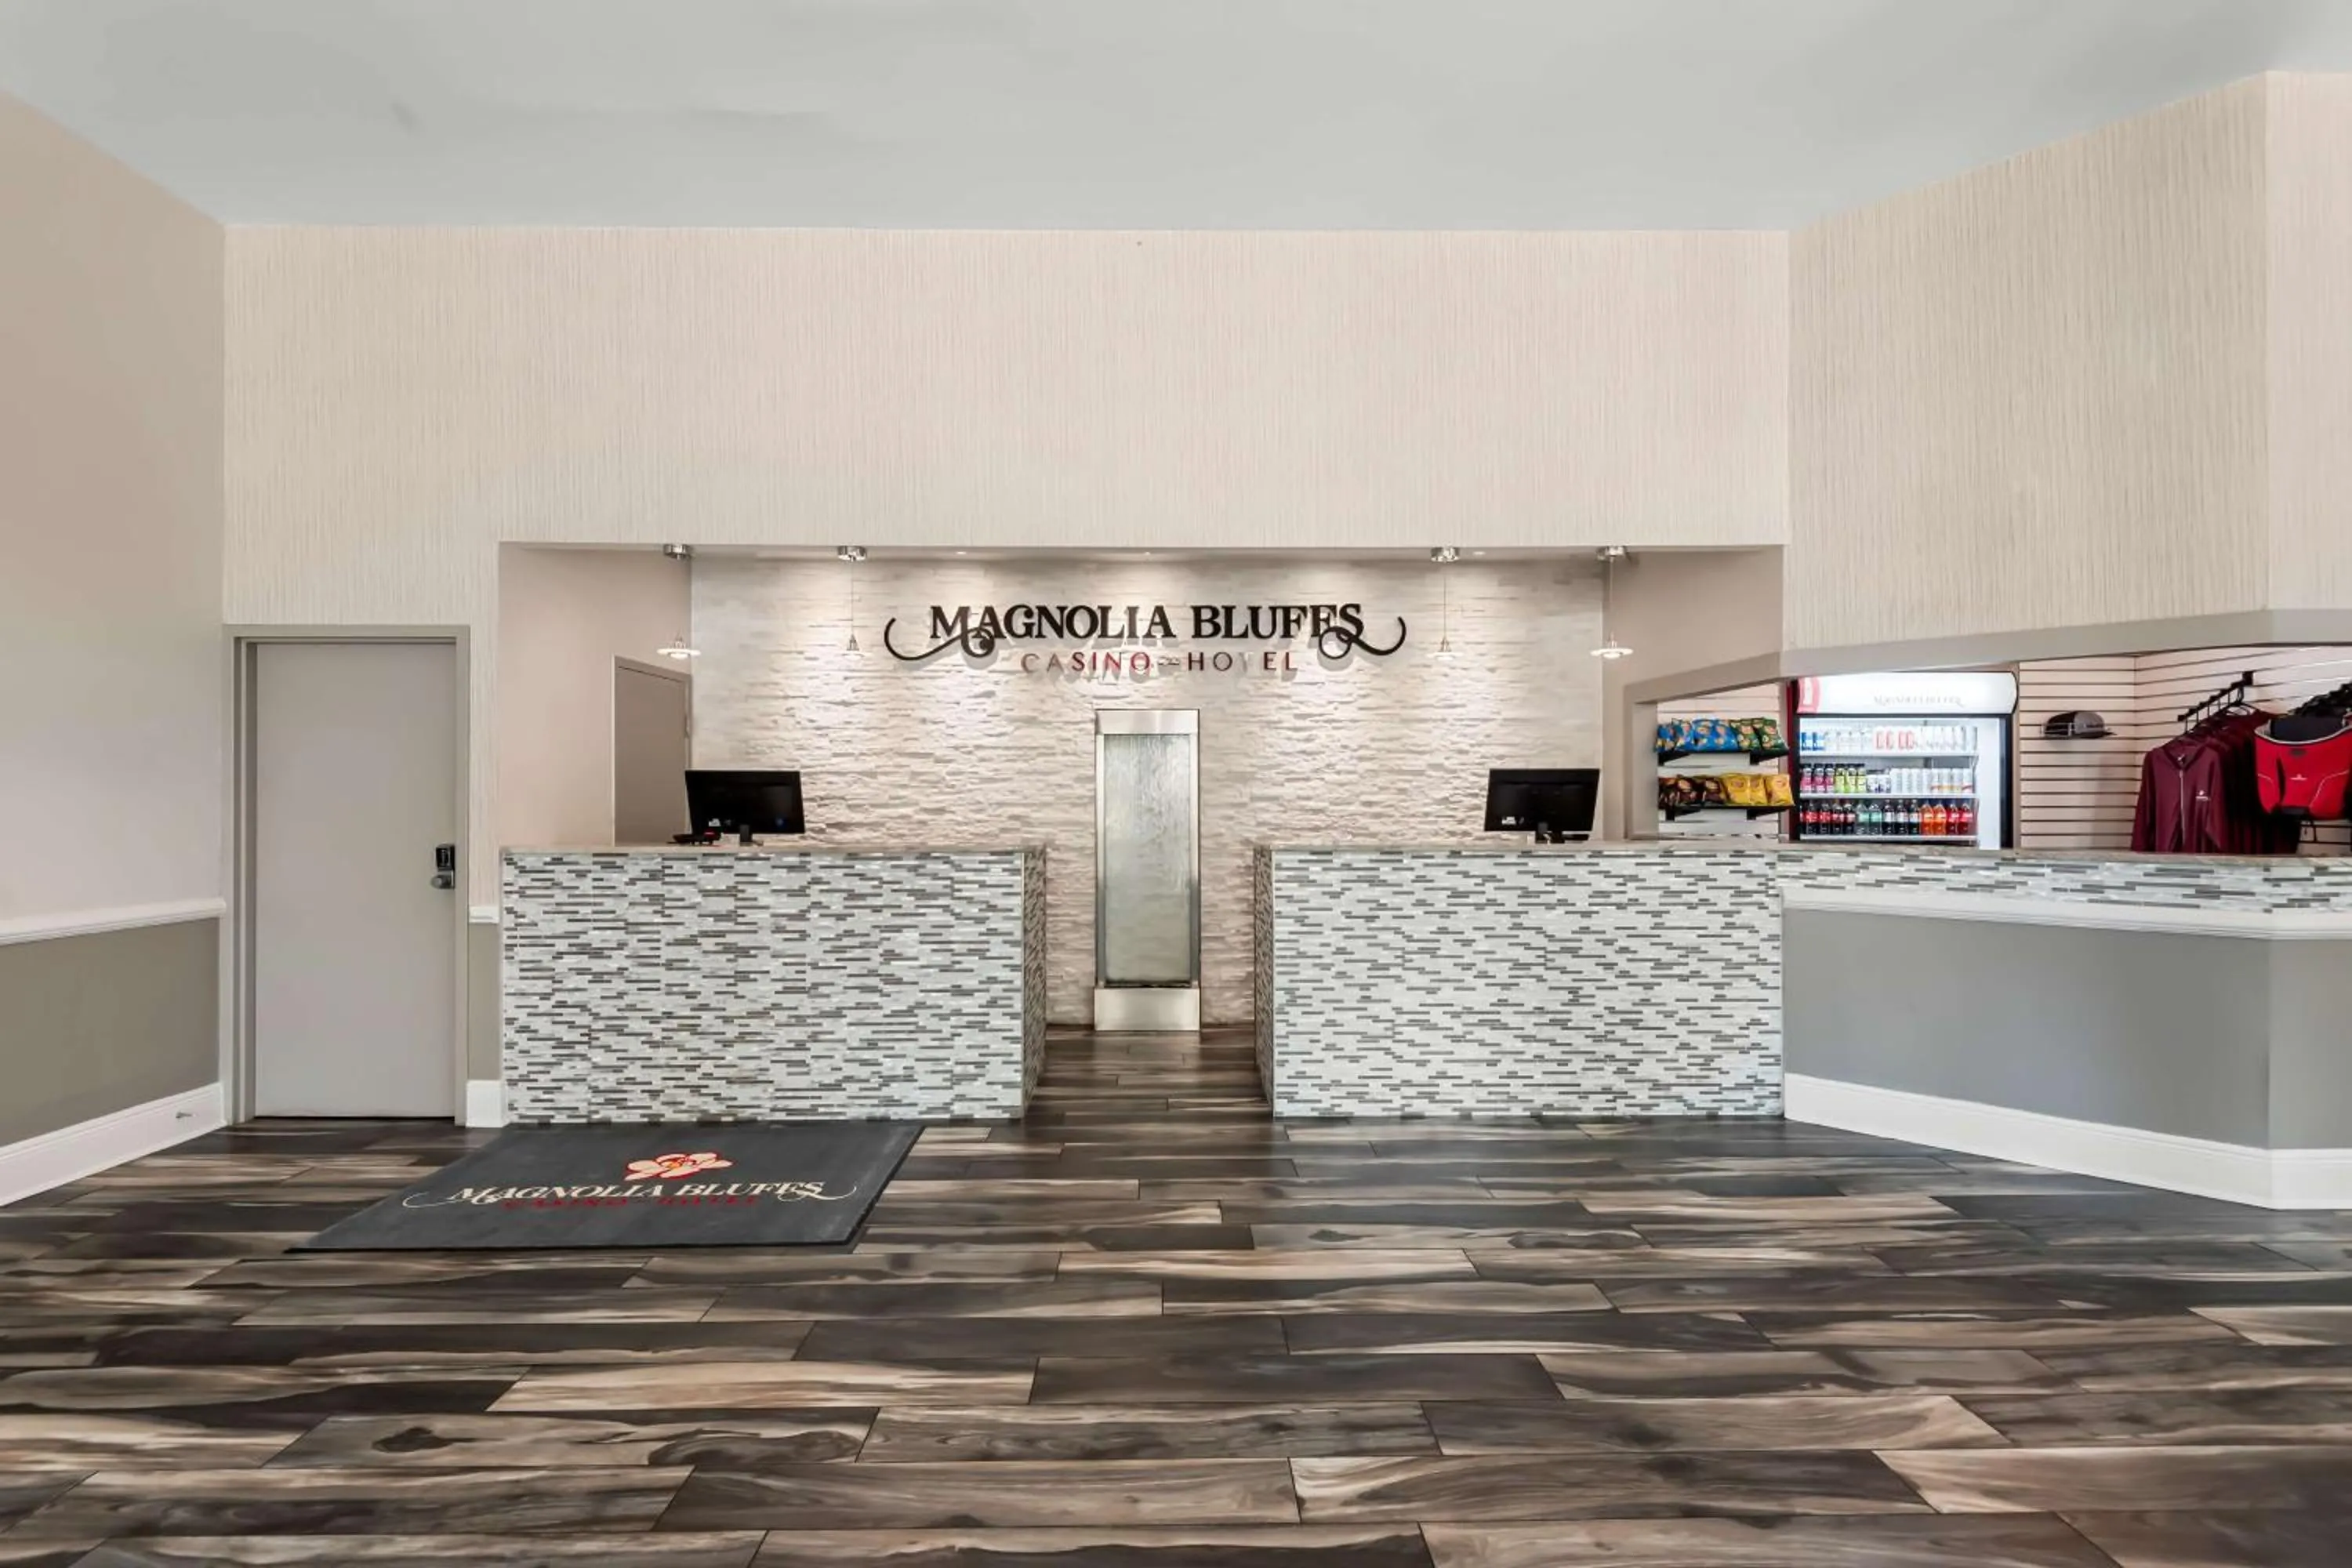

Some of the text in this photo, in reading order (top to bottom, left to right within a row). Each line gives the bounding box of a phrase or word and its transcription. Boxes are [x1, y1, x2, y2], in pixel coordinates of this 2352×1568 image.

[930, 603, 1364, 654] MAGNOLIA BLUFFS
[1021, 652, 1150, 672] CASINO
[449, 1185, 664, 1203] MAGNOLIA
[675, 1181, 826, 1200] BLUFFS
